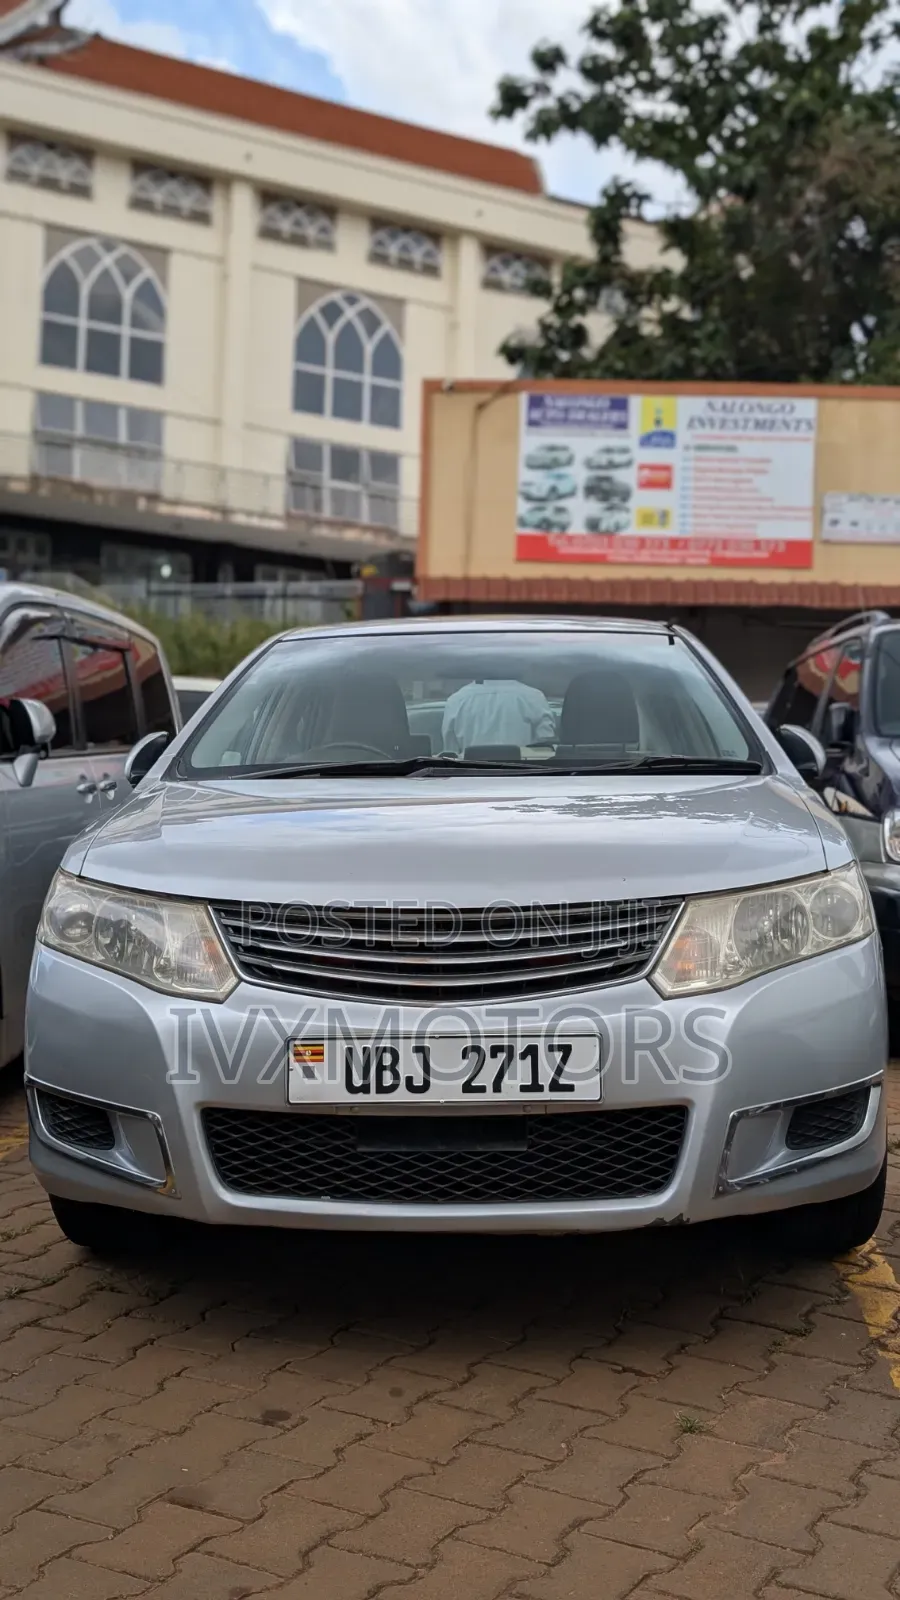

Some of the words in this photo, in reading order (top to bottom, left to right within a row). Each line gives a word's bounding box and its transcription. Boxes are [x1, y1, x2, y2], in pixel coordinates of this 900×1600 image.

[704, 400, 797, 414] NALONGO
[686, 416, 816, 432] INVESTMENTS
[344, 1045, 431, 1094] UBJ
[461, 1043, 575, 1093] 271Z
